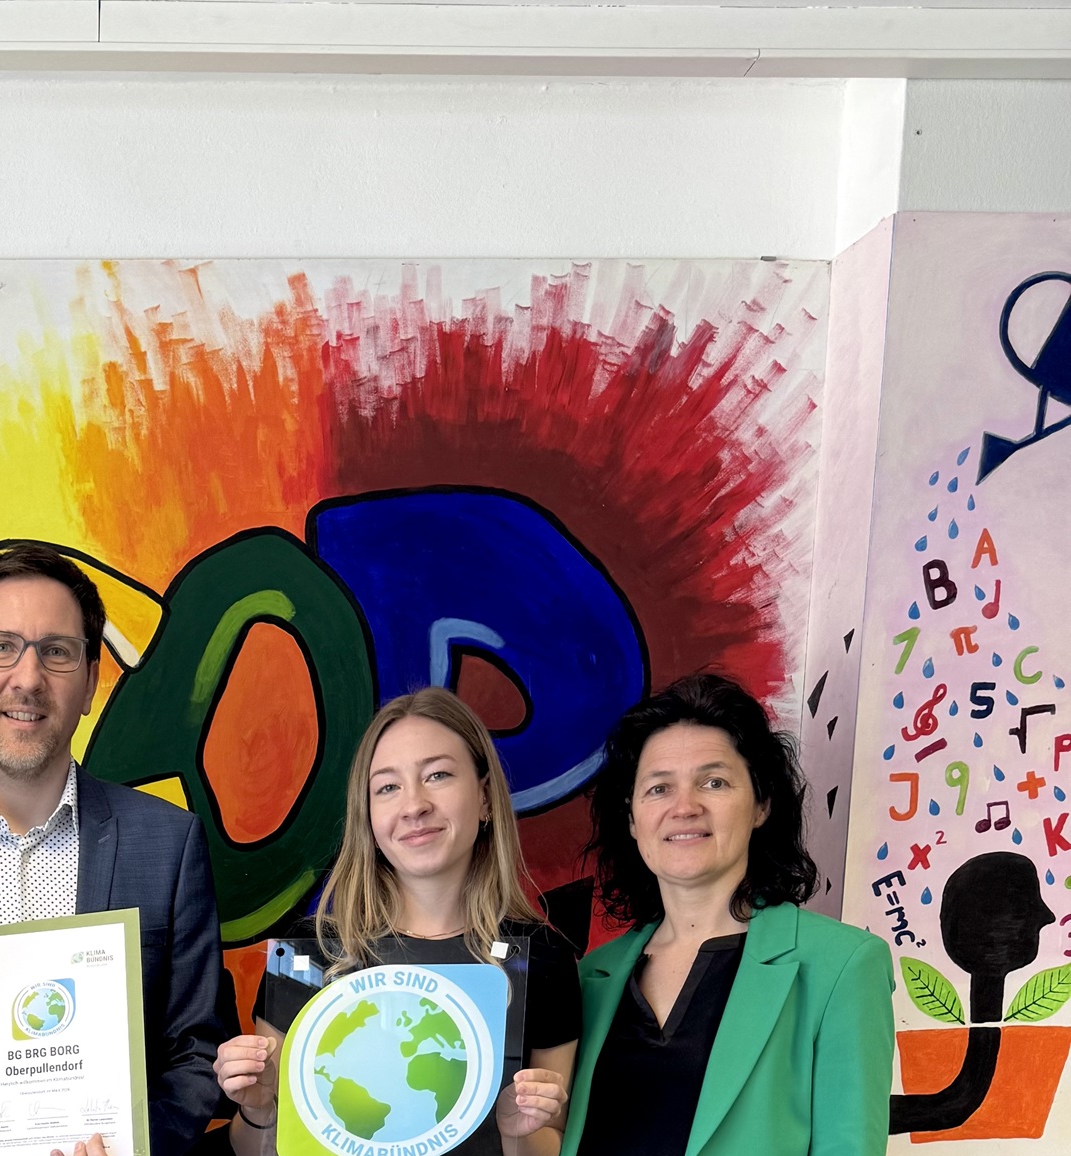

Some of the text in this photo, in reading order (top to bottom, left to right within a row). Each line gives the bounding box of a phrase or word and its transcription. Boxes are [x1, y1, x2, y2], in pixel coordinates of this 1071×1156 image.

[971, 528, 998, 569] A
[922, 559, 958, 610] B
[1013, 645, 1043, 685] C
[969, 682, 996, 719] 5
[889, 772, 919, 822] J
[945, 760, 970, 816] 9
[1042, 812, 1071, 857] K
[85, 949, 106, 957] KLIMA
[30, 982, 41, 990] WIR
[349, 971, 439, 995] WIR SIND
[5, 1059, 84, 1077] Oberpullendorf
[7, 1044, 80, 1061] BG BRG BORG
